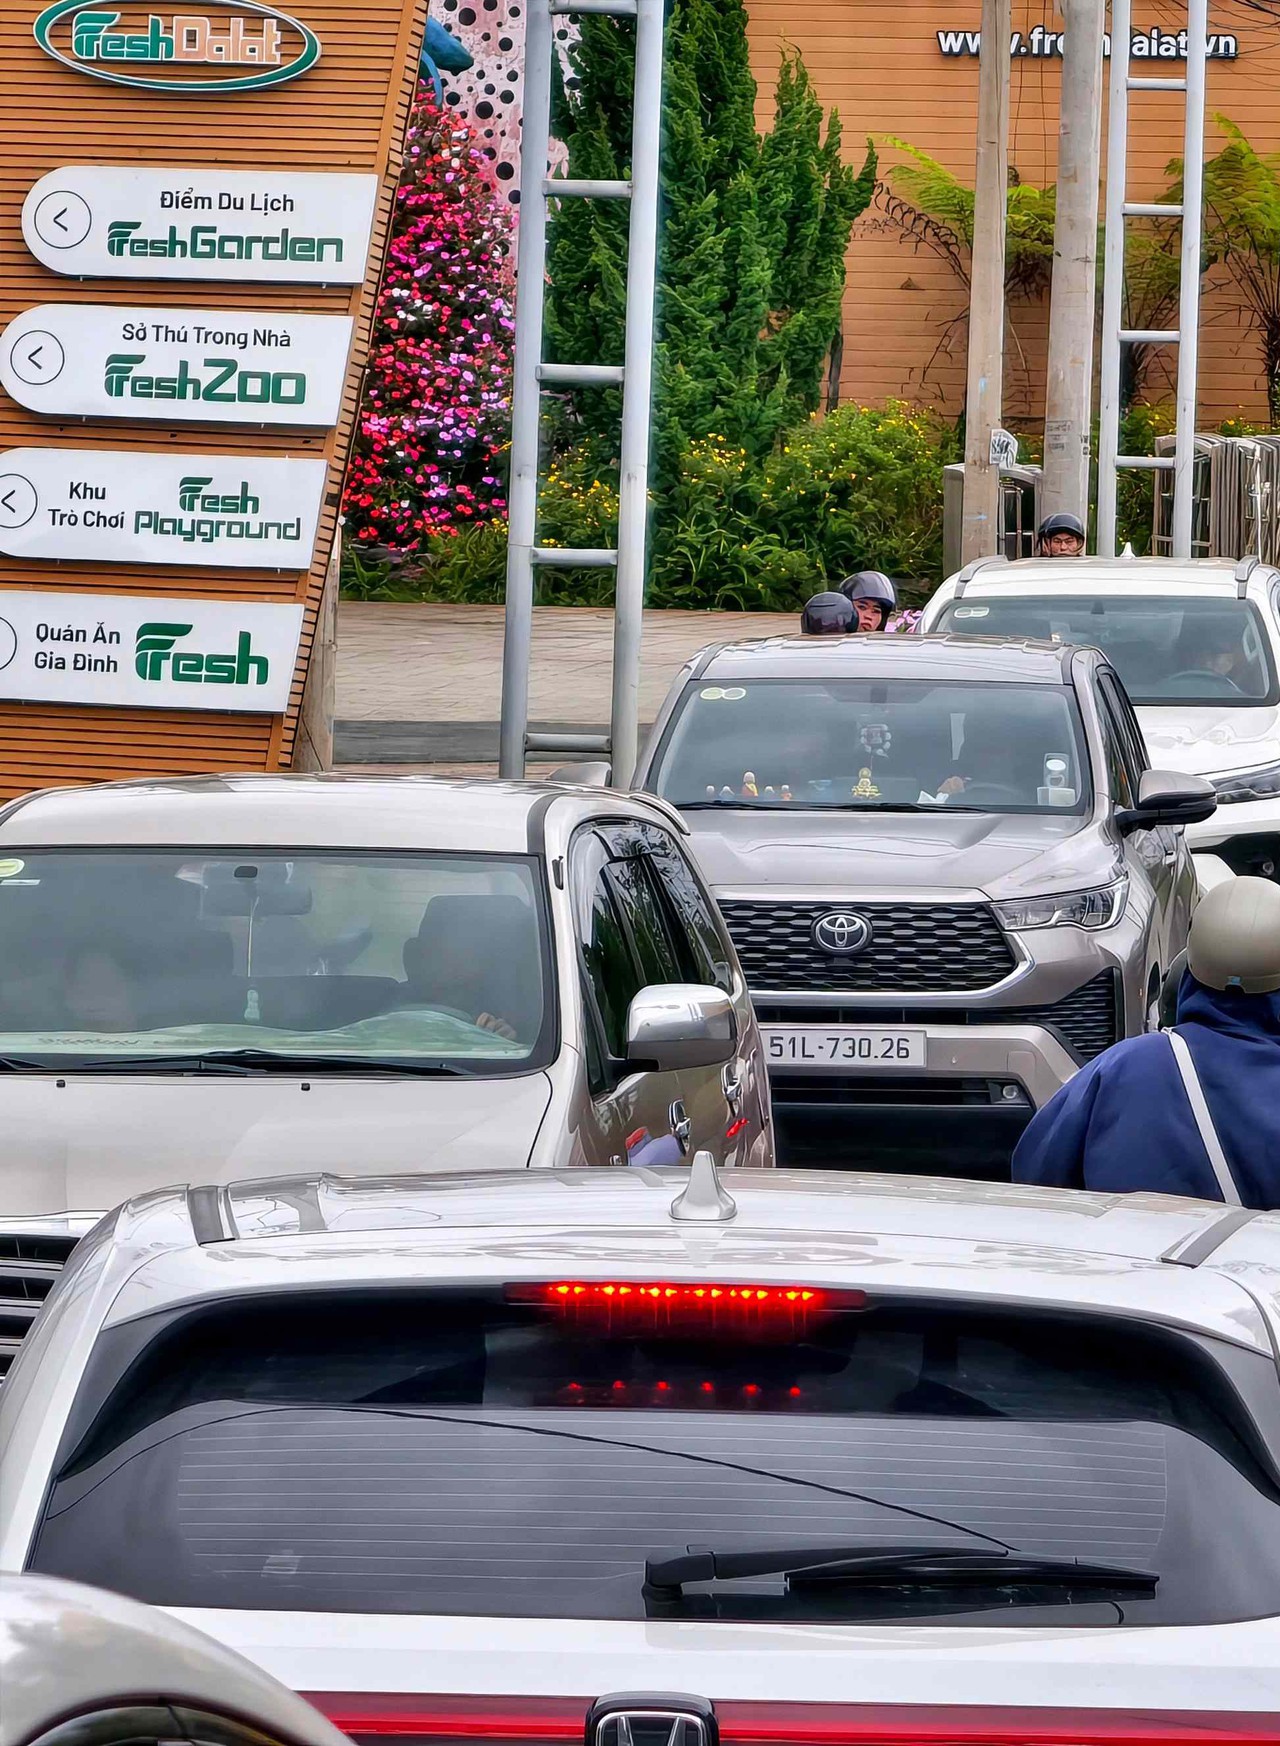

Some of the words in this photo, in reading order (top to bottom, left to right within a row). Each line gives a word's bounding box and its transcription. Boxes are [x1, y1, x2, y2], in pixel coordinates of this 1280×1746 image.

[160, 188, 212, 211] Điểm
[218, 192, 244, 211] Du
[250, 193, 294, 216] Lịch
[107, 221, 343, 263] FreshGarden
[122, 323, 146, 342] Sở
[152, 324, 188, 344] Thú
[194, 327, 248, 350] Trong
[253, 329, 291, 347] Nhà
[105, 354, 306, 405] FreshZoo
[69, 481, 106, 501] Khu
[178, 476, 260, 514] Fresh
[48, 508, 78, 527] Trò
[83, 510, 125, 529] Chơi
[133, 510, 301, 543] Playground
[36, 623, 87, 644] Quán
[93, 621, 121, 645] Ăn
[34, 652, 66, 671] Gia
[73, 652, 118, 673] Đình
[135, 622, 269, 685] Fresh
[769, 1035, 911, 1060] 51L-730.26
